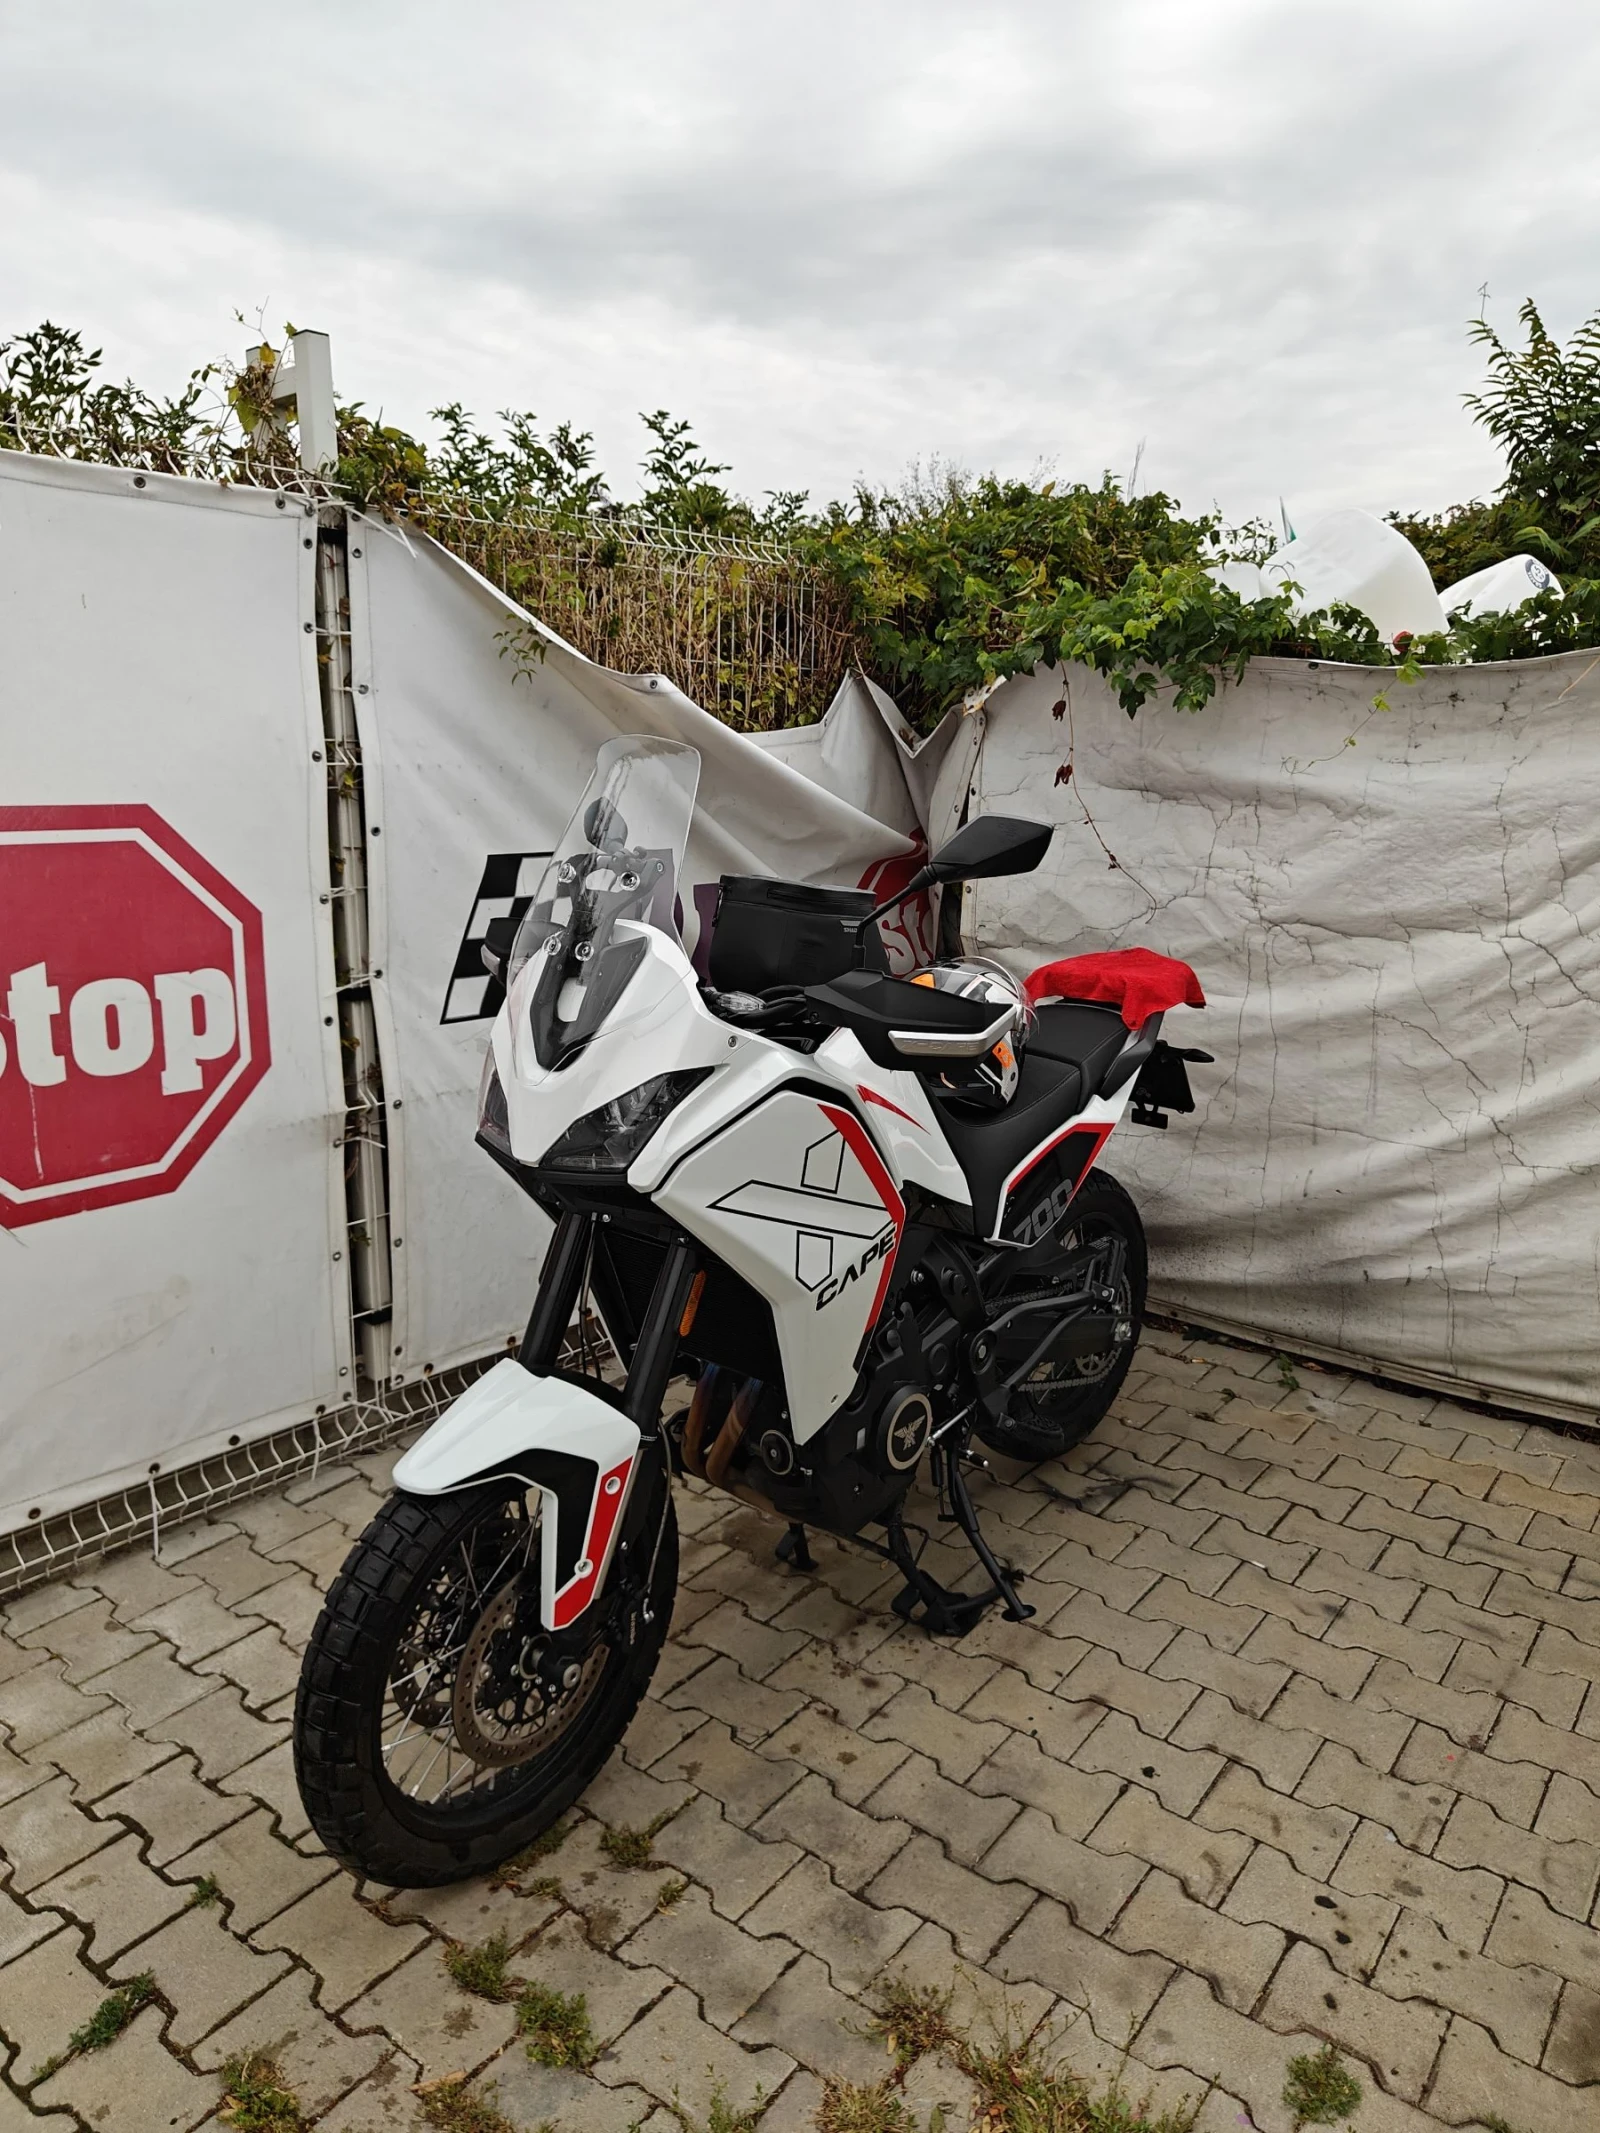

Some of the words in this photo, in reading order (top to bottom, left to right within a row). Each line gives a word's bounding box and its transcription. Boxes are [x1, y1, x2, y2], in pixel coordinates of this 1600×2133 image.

[0, 961, 237, 1095] top
[1012, 1178, 1073, 1245] 700
[816, 1225, 897, 1311] CAPE
